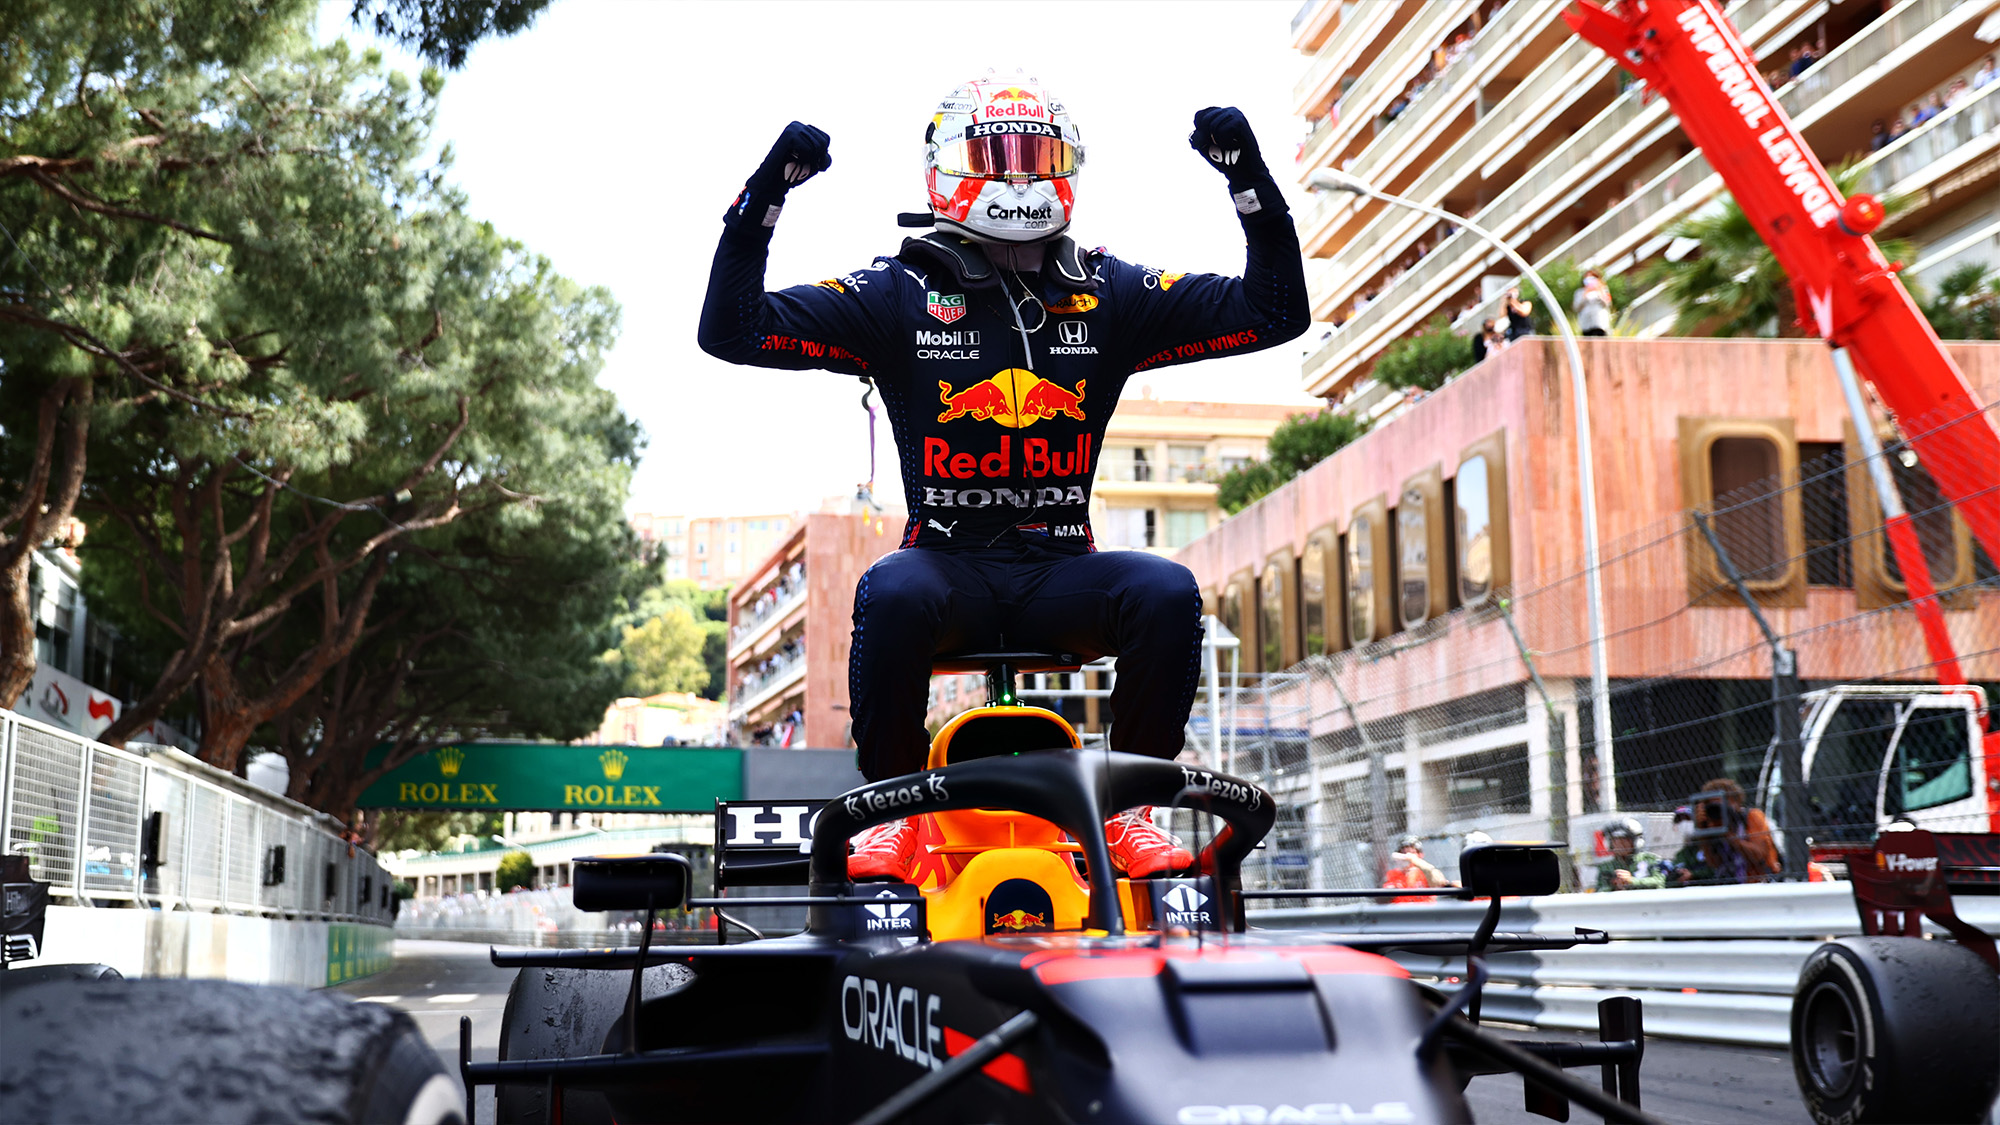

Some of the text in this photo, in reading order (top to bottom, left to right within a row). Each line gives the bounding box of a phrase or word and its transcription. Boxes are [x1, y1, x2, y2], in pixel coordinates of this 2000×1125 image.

[986, 102, 1015, 118] Red
[1017, 103, 1044, 118] Bull
[1676, 5, 1839, 228] IMPERIAL LEVAGE
[973, 122, 1056, 137] HONDA
[987, 204, 1052, 219] CarNext
[1023, 220, 1047, 229] .com
[930, 293, 961, 306] TAG
[1056, 298, 1092, 308] RAUCH
[930, 305, 964, 321] HEUER
[916, 330, 962, 346] Mobil
[801, 340, 826, 357] YOU
[917, 349, 980, 360] ORACLE
[1049, 346, 1099, 355] HONDA
[1135, 329, 1258, 371] GIVES YOU WINGS
[924, 433, 1092, 479] Red Bull
[923, 485, 1086, 508] HONDA
[1054, 524, 1086, 537] MAX
[400, 782, 499, 804] ROLEX
[563, 784, 662, 806] ROLEX
[1201, 771, 1248, 803] Tezos
[863, 784, 923, 812] Tezos
[1885, 853, 1938, 872] V-Power
[867, 918, 911, 929] INTER
[1166, 912, 1210, 922] INTER
[842, 975, 944, 1072] ORACLE
[1177, 1101, 1416, 1125] ORACLE
